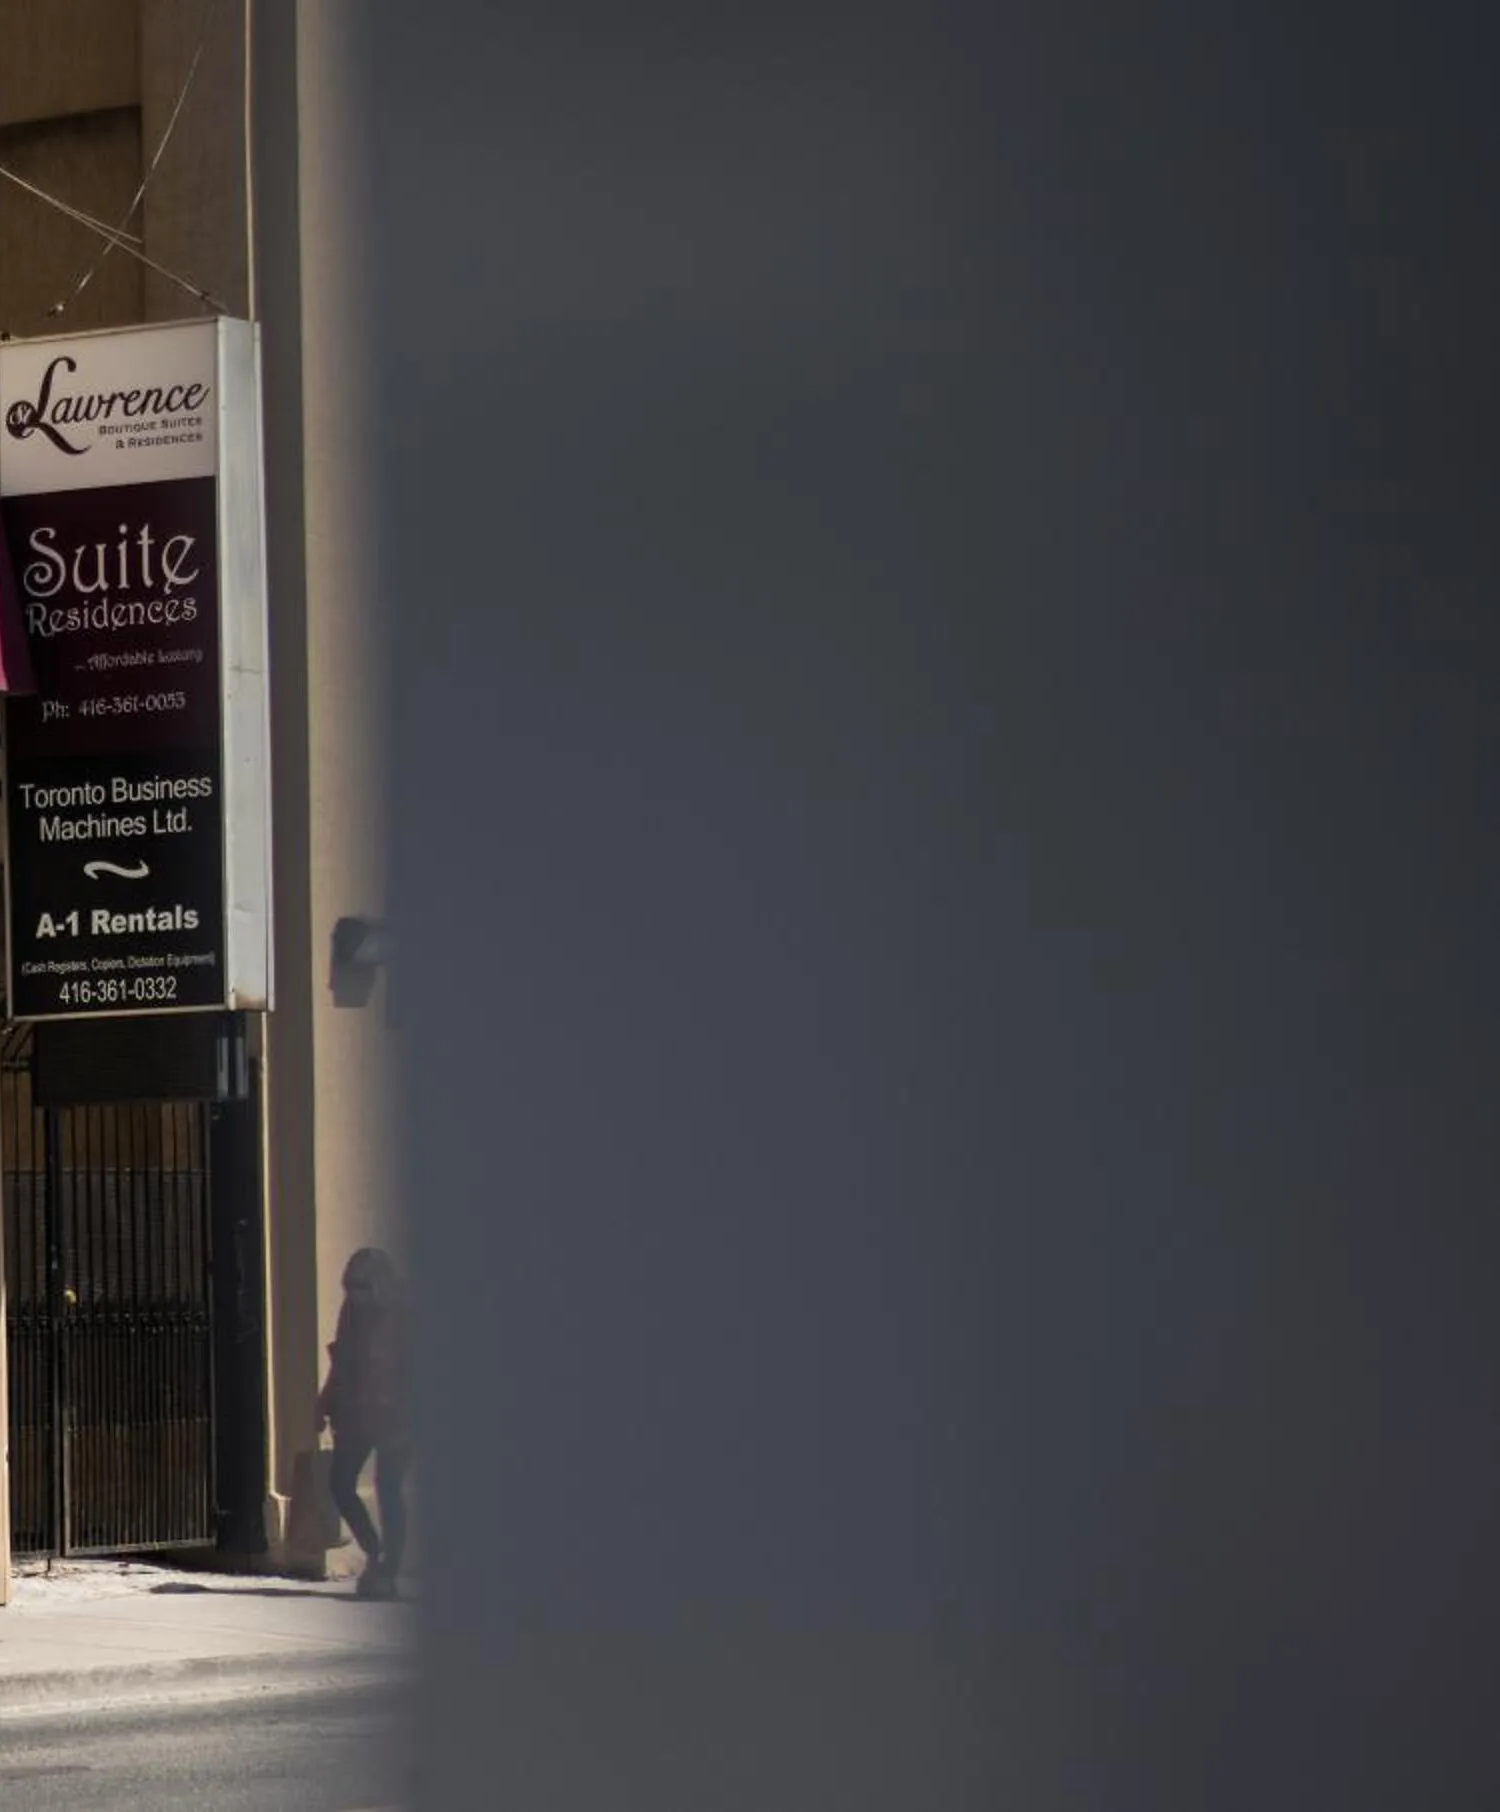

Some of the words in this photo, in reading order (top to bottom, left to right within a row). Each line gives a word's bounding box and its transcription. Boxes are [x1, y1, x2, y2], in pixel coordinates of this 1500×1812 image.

[6, 356, 211, 456] Lawrence
[23, 523, 200, 597] Suite
[26, 596, 198, 638] Residences
[19, 782, 106, 810] Toronto
[111, 775, 213, 803] Business
[39, 812, 147, 843] Machines
[153, 806, 193, 834] Ltd.
[35, 910, 81, 939] A-1
[91, 904, 200, 935] Rentals
[59, 975, 177, 1004] 416-361-0332
